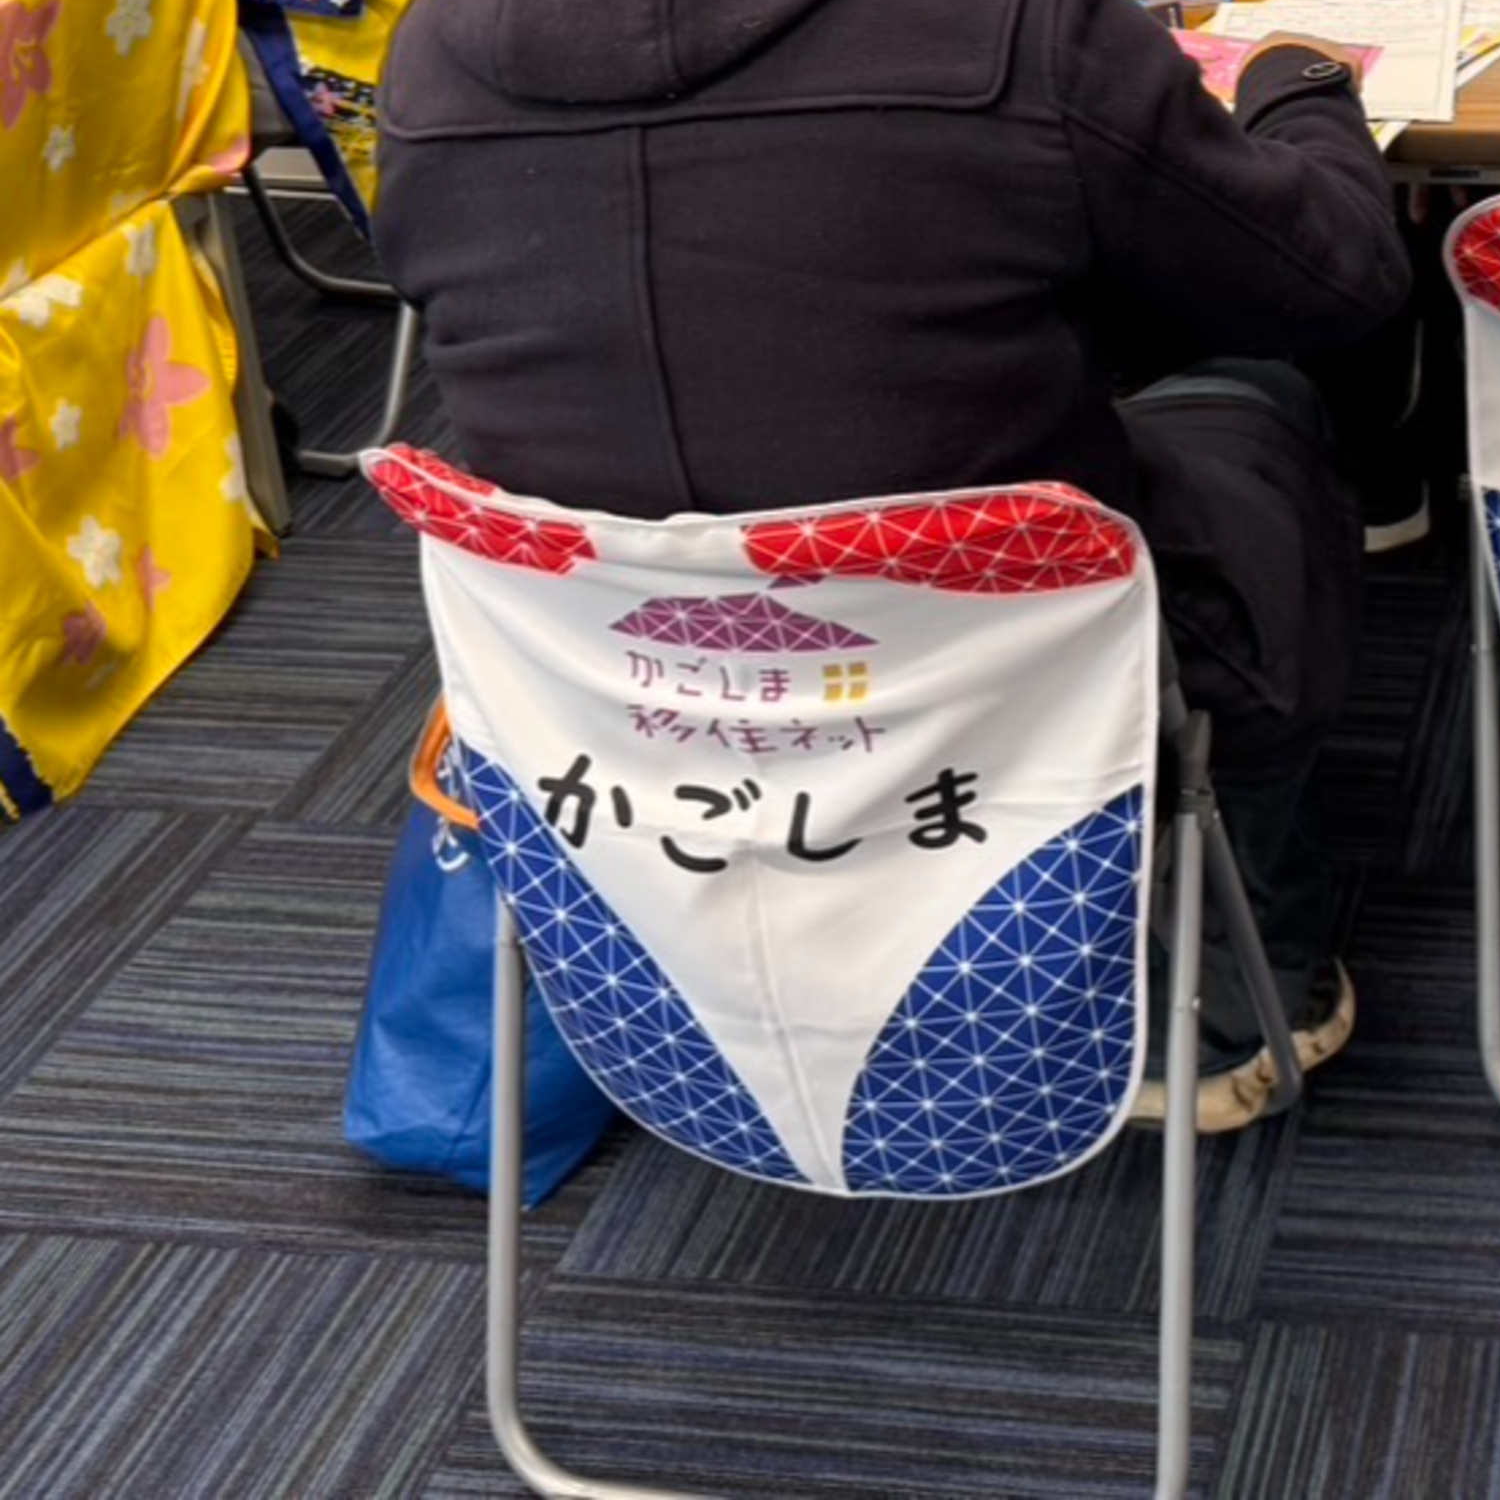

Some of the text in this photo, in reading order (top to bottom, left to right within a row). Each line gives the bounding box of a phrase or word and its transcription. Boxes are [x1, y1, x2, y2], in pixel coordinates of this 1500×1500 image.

[626, 650, 791, 702] かごしま
[626, 703, 886, 754] 移住ネット
[537, 753, 988, 874] かごしま
